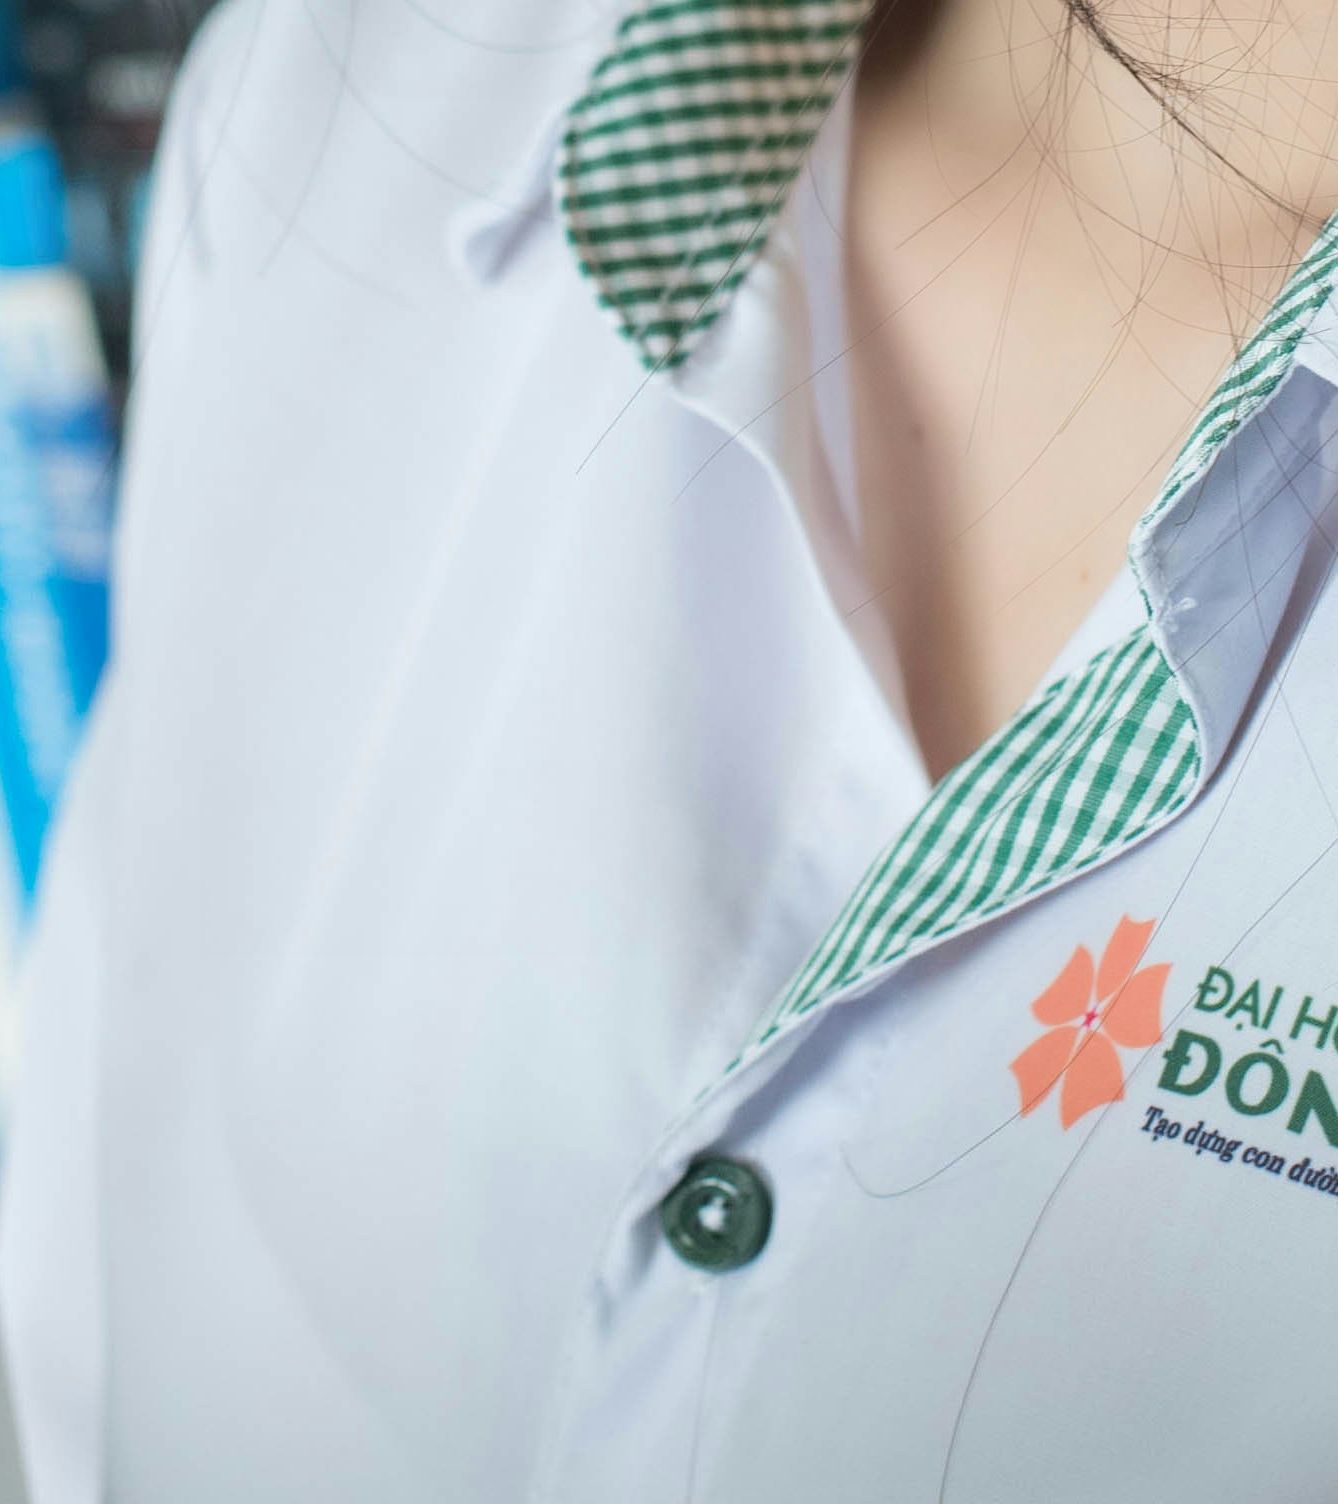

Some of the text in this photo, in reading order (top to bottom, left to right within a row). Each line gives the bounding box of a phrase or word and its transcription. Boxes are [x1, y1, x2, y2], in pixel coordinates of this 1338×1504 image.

[1194, 965, 1285, 1031] ĐẠI
[1140, 1104, 1181, 1141] Tạo
[1183, 1120, 1244, 1163] dựng
[1241, 1145, 1287, 1175] con
